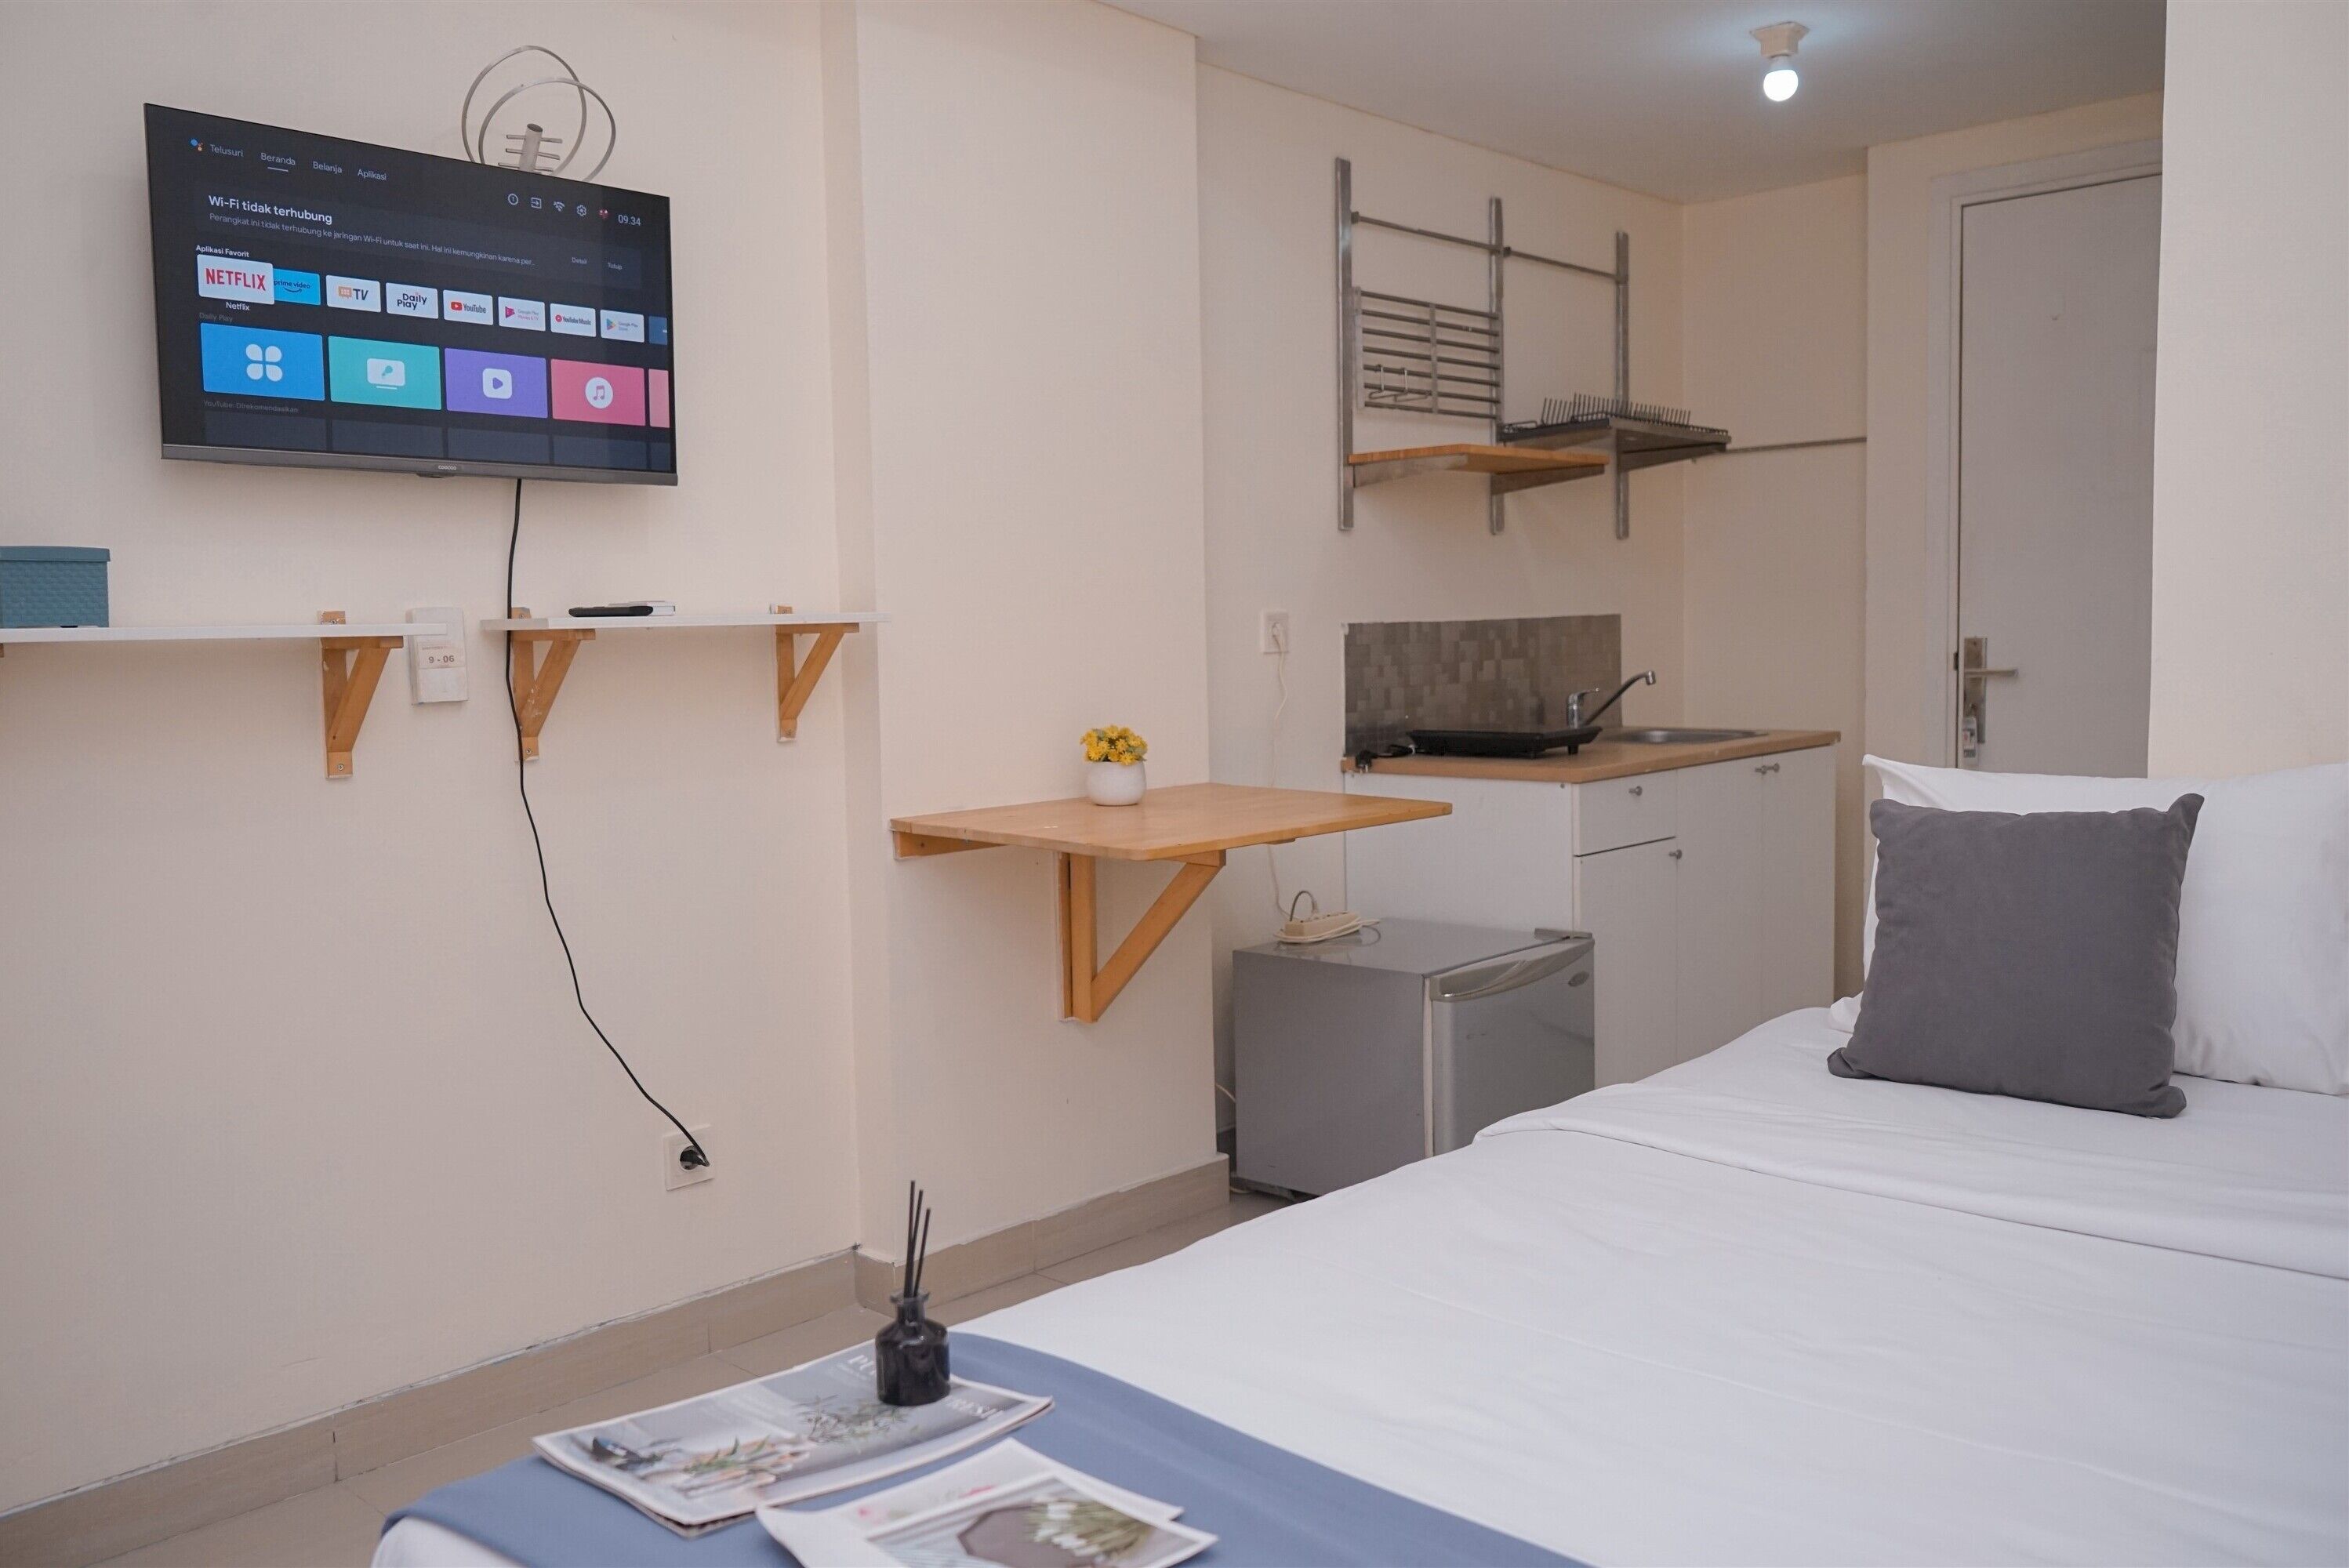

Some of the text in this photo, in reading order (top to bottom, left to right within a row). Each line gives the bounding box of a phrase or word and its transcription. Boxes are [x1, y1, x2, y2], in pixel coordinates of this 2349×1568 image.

[210, 143, 244, 157] Telusuri
[260, 152, 296, 166] Beranda
[313, 161, 343, 174] Belanja
[358, 169, 387, 181] Aplikasi
[209, 195, 332, 225] Wi-Fi tidak terhubung
[618, 214, 641, 227] 09.34
[209, 212, 249, 226] Perangkat
[251, 218, 260, 227] ini
[261, 220, 281, 230] tidak
[282, 223, 322, 237] terhubung
[333, 230, 362, 241] jaringan
[363, 235, 383, 244] Wi-Fi
[383, 238, 403, 248] untuk
[404, 241, 419, 250] saat
[431, 244, 443, 253] Hal
[444, 245, 452, 254] ini
[452, 248, 497, 260] kemungkinan
[498, 254, 521, 264] karena
[195, 245, 250, 258] Aplikasi Favorit
[205, 267, 267, 292] NETFLIX
[273, 278, 311, 289] prime video
[353, 288, 369, 301] TV
[402, 292, 427, 305] Daily
[226, 302, 250, 311] Netflix
[397, 299, 418, 310] Play
[463, 303, 487, 314] YouTube
